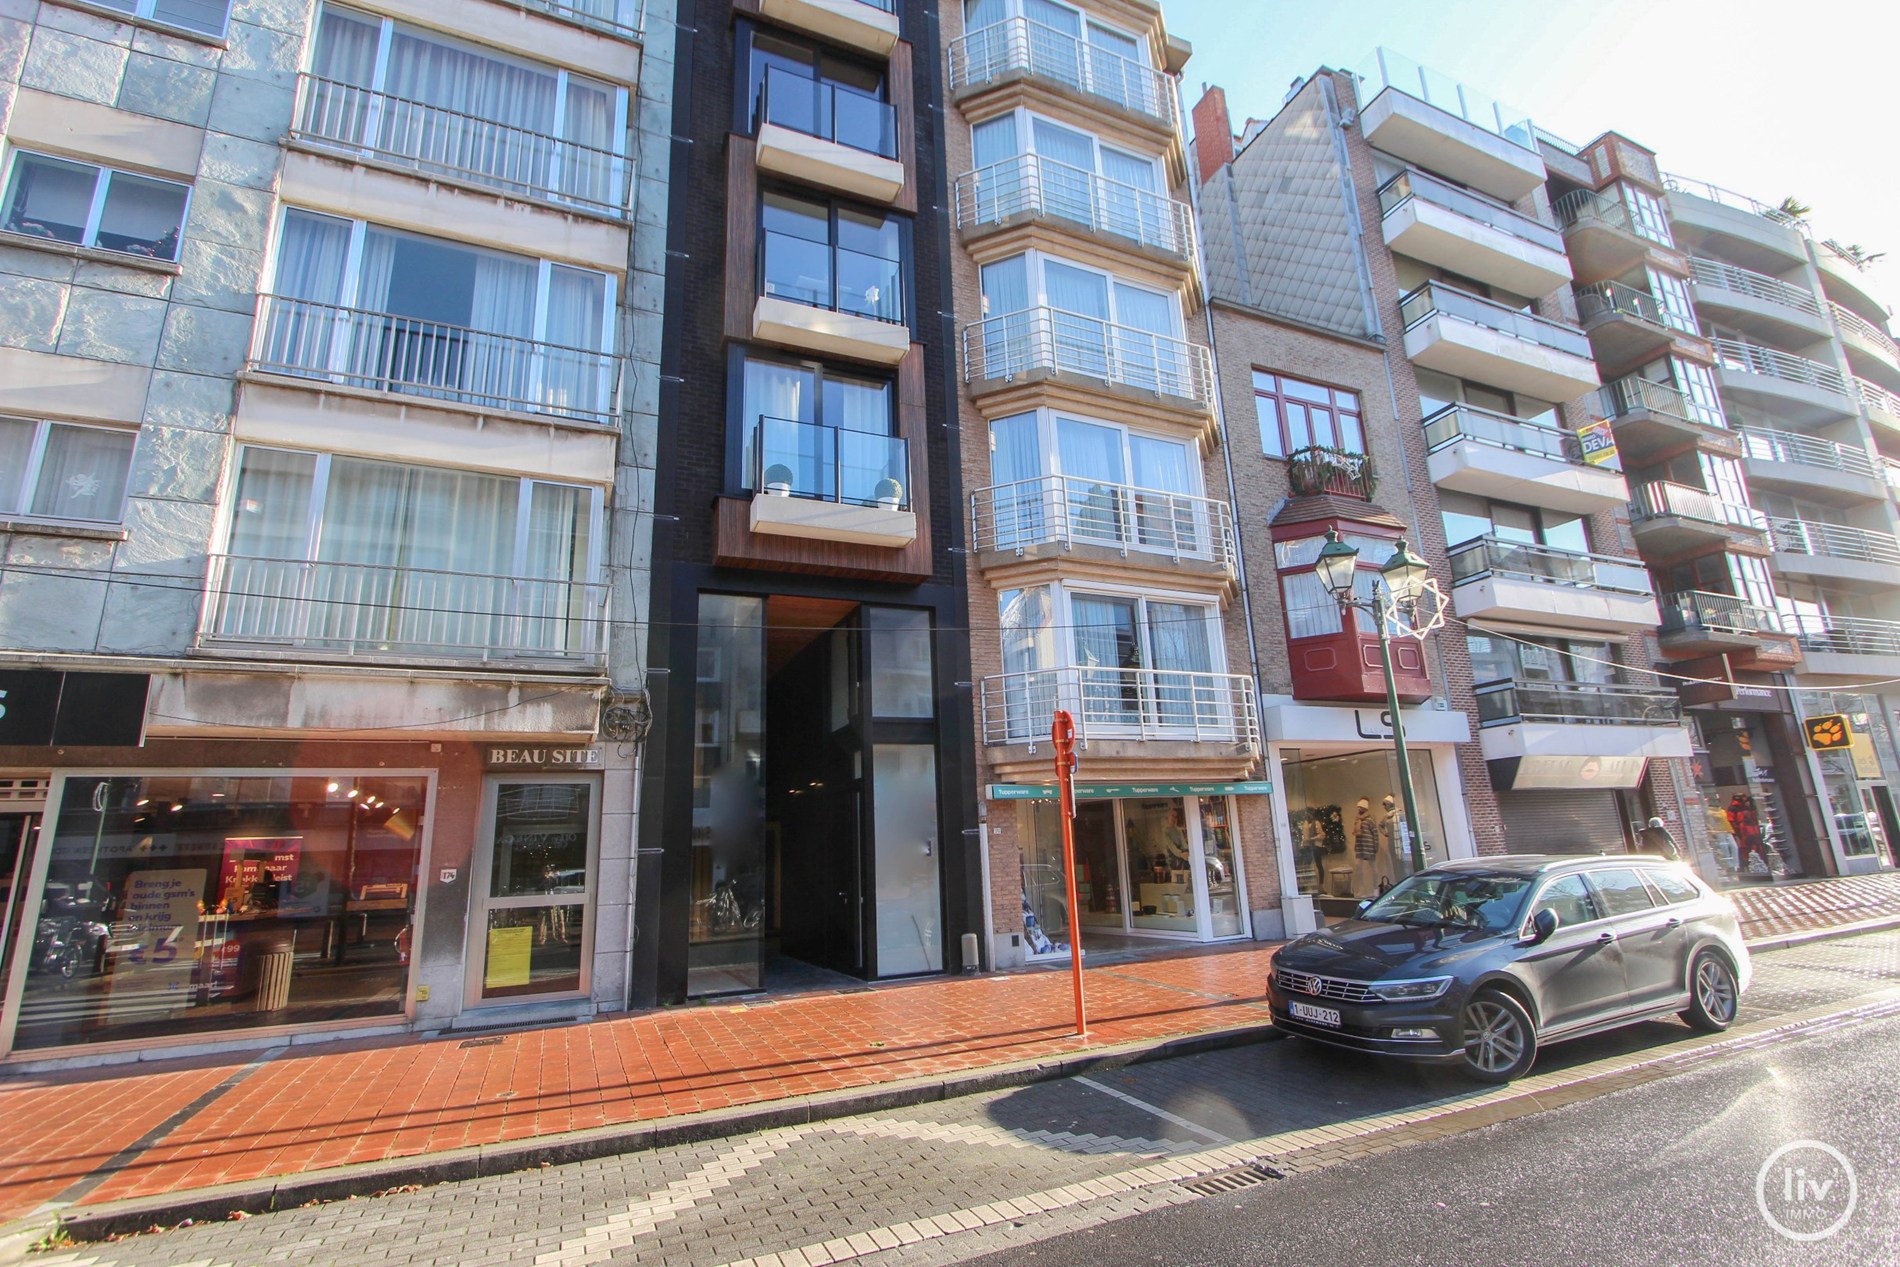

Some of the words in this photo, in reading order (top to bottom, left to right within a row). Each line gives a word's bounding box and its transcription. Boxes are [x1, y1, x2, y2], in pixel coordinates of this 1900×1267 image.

[490, 749, 547, 764] BEAU
[551, 749, 599, 764] SITE
[134, 880, 169, 889] Breng
[163, 888, 195, 899] gsm's
[145, 912, 171, 921] krijg
[1294, 1004, 1339, 1023] 1-UUJ-212
